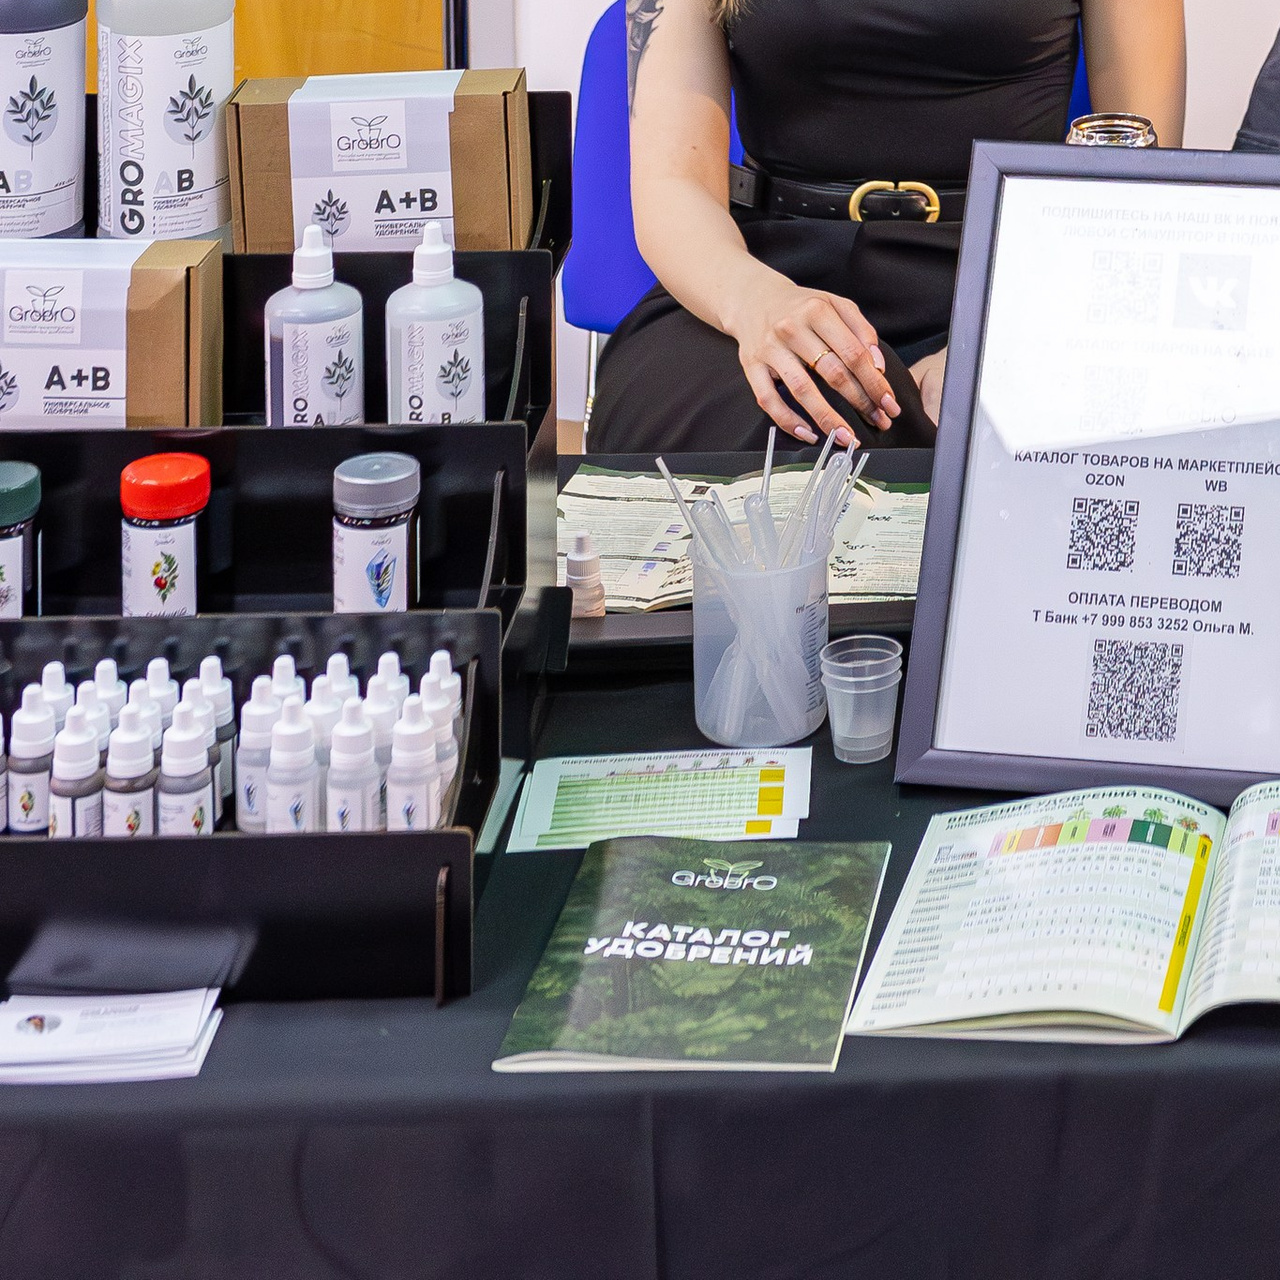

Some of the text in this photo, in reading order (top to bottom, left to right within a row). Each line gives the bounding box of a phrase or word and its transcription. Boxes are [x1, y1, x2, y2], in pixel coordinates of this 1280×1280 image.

[337, 134, 401, 152] GrobrO
[1153, 210, 1173, 222] НА
[9, 305, 76, 322] GrobrO
[1014, 450, 1080, 465] КАТАЛОГ
[1082, 453, 1150, 468] ТОВАРОВ
[1153, 457, 1174, 470] НА
[1085, 473, 1125, 487] OZON
[1205, 479, 1228, 493] WB
[1068, 592, 1223, 614] ОПЛАТА ПЕРЕВОДОМ
[1044, 610, 1078, 625] Банк
[1082, 613, 1098, 626] +7
[1101, 614, 1125, 628] 999
[1129, 615, 1153, 630] 853
[1157, 617, 1189, 632] 3252
[1192, 620, 1235, 637] Ольга
[622, 920, 791, 947] КАТАЛОГ
[583, 937, 813, 966] УДОБРЕНИЙ
